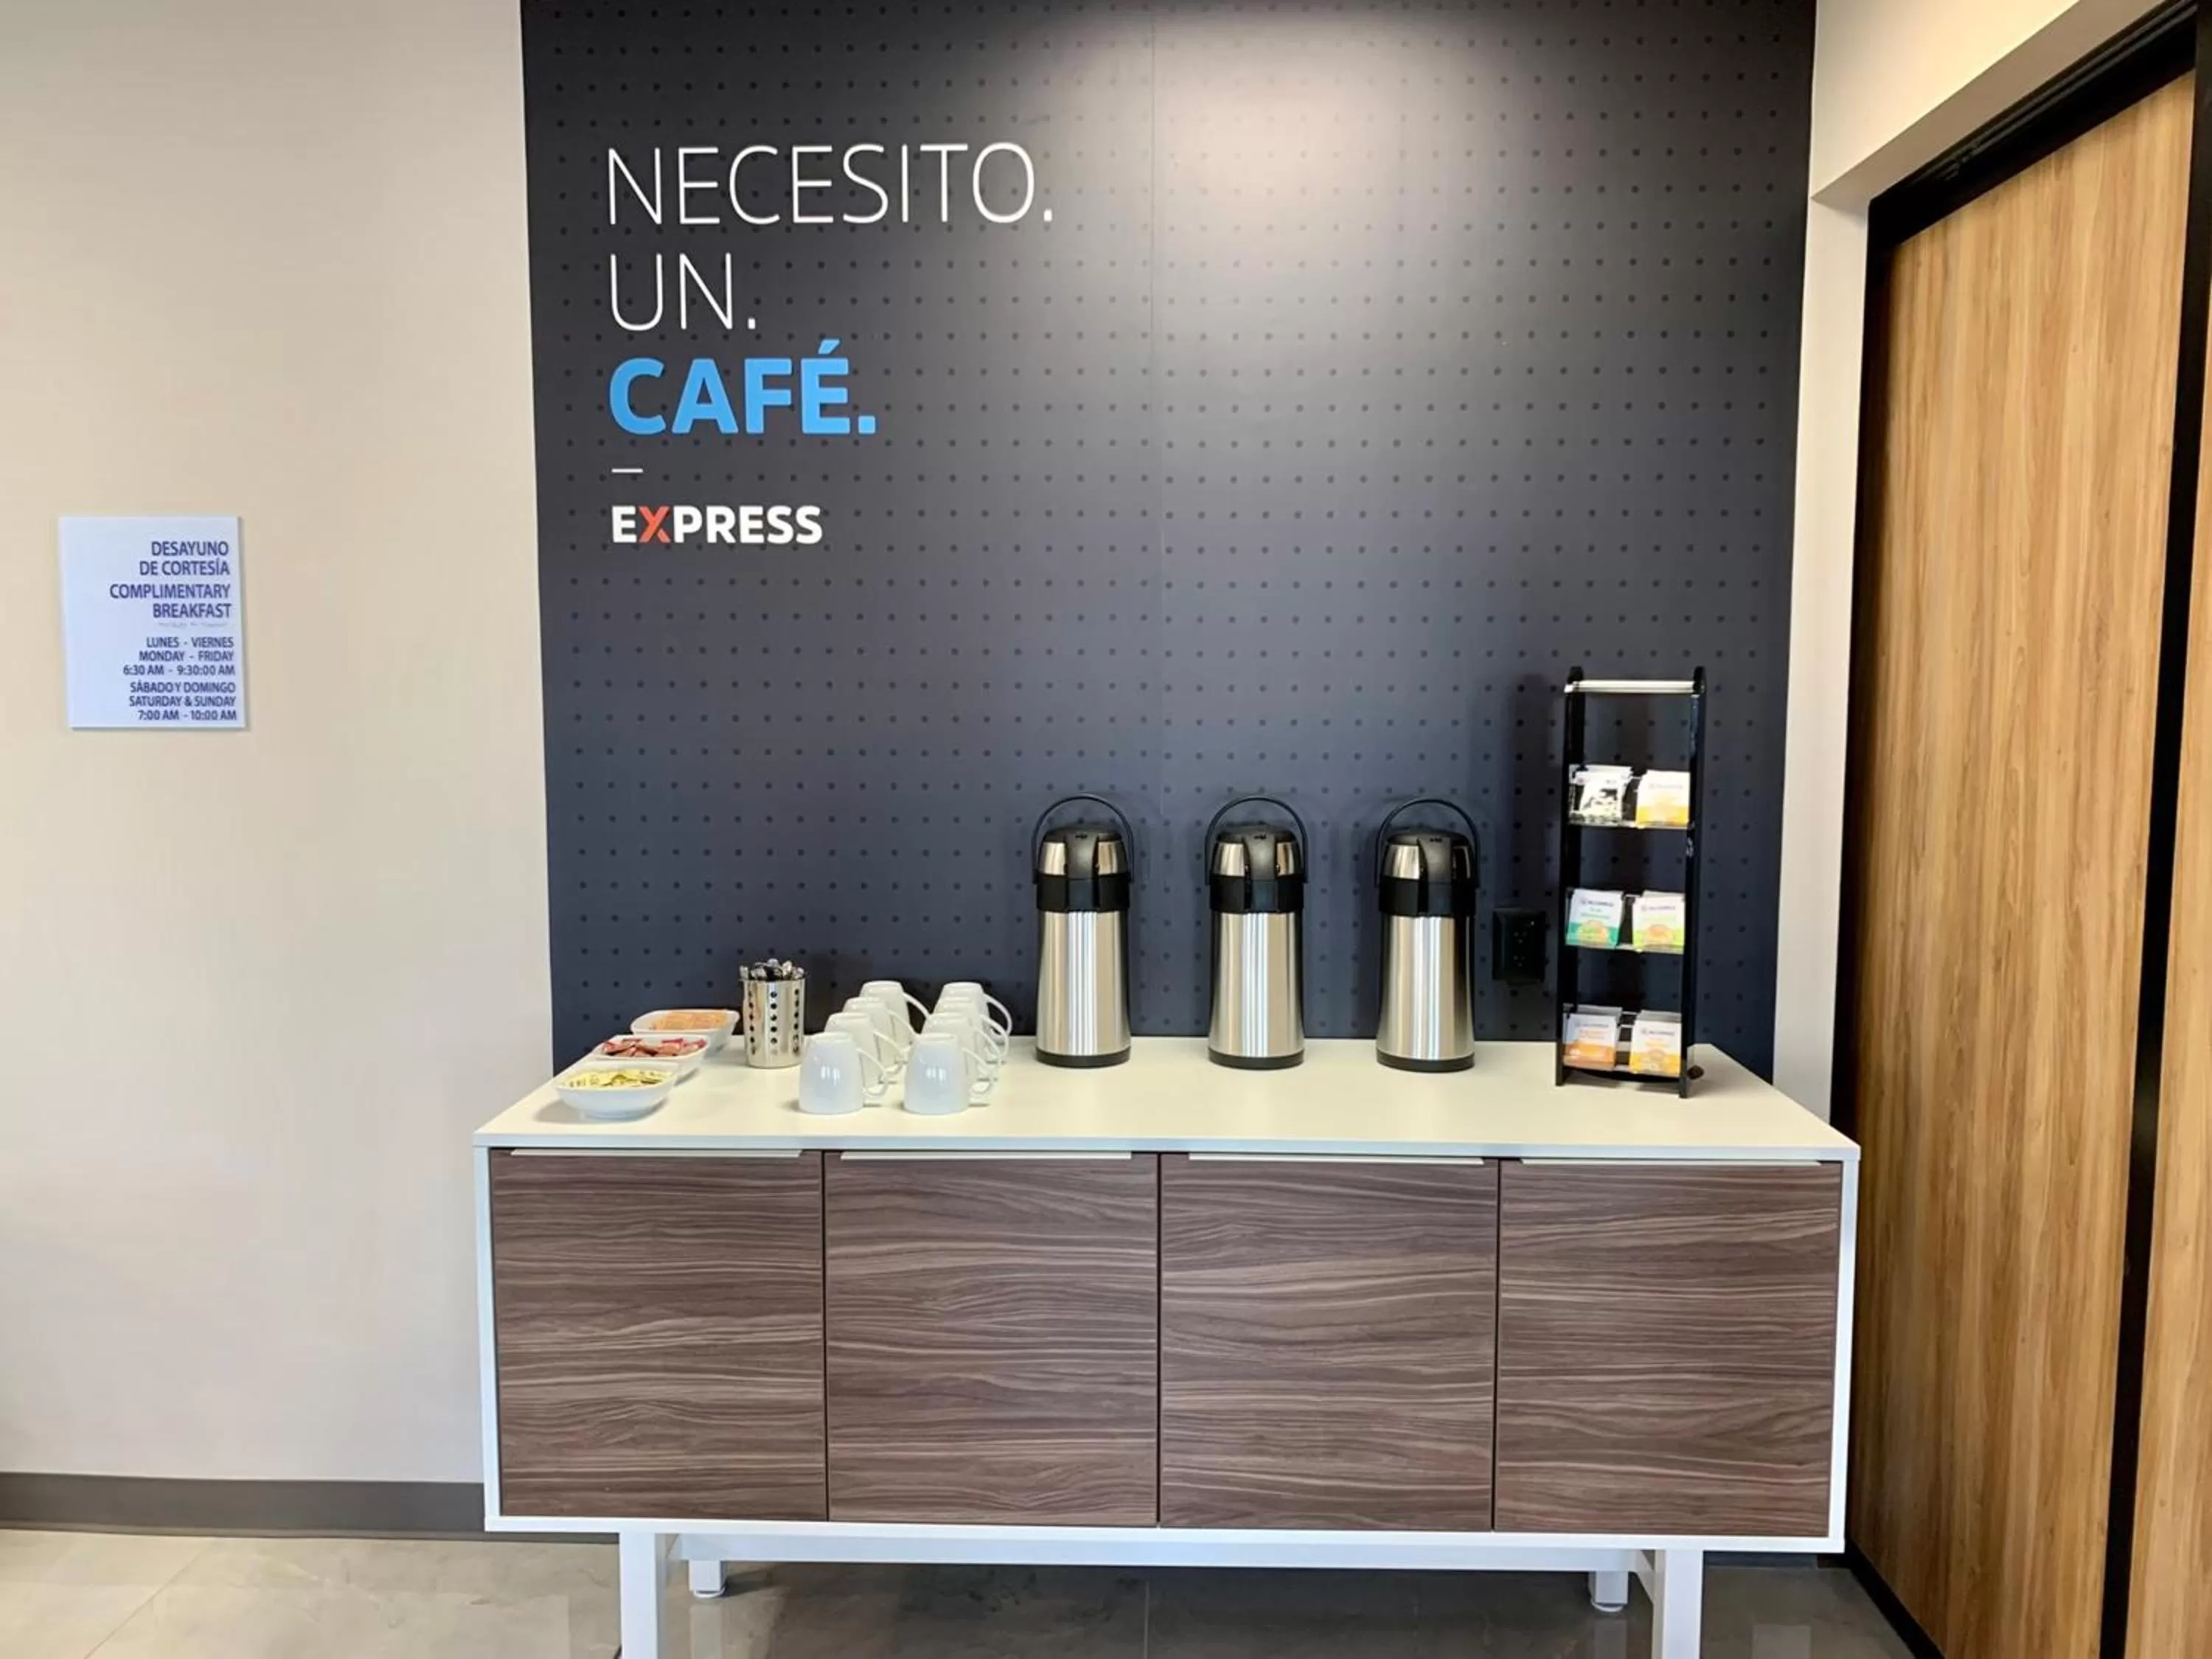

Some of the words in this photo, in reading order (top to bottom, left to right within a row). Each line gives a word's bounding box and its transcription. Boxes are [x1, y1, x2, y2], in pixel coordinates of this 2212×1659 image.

[608, 142, 1053, 225] NECESITO.
[611, 252, 756, 331] UN.
[609, 338, 877, 435] CAFÉ.
[611, 505, 823, 544] EXPRESS
[150, 540, 229, 557] DESAYUNO
[139, 561, 159, 576] DE
[161, 557, 230, 576] CORTESÍA
[109, 583, 231, 599] COMPLIMENTARY
[152, 602, 232, 619] BREAKFAST
[146, 636, 180, 648] LUNES
[191, 636, 234, 648] VIERNES
[139, 650, 185, 662] MONDAY
[198, 650, 234, 662] FRIDAY
[122, 664, 146, 676] 6:30
[147, 664, 165, 676] AM
[176, 664, 217, 676] 9:30:00
[218, 664, 236, 676] AM
[130, 680, 173, 694] SÁBADO
[183, 681, 236, 694] DOMINGO
[128, 695, 183, 708] SATURDAY
[184, 695, 193, 708] &
[193, 695, 237, 708] SUNDAY
[138, 709, 161, 721] 7:00
[161, 709, 180, 721] AM
[190, 709, 218, 721] 10:00
[219, 709, 238, 721] AM
